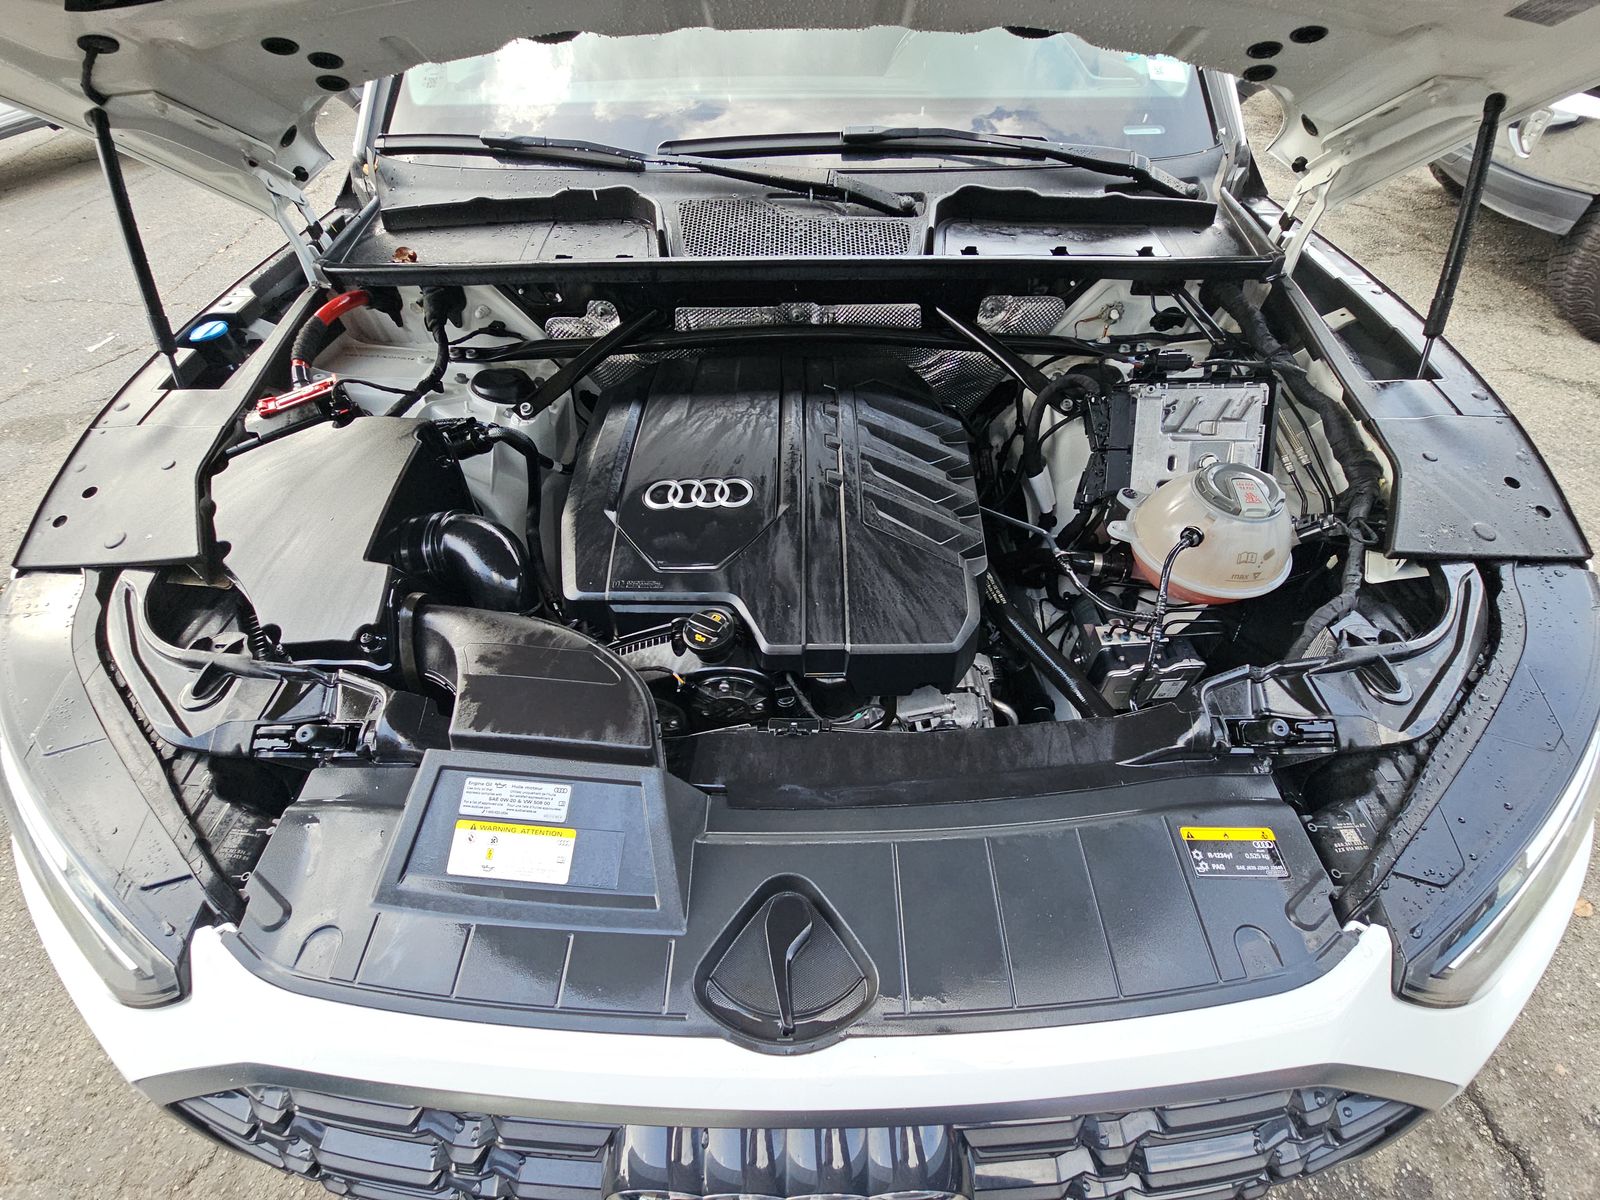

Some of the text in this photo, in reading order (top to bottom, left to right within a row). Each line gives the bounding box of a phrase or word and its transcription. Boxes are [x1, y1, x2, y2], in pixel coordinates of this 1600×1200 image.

[480, 825, 563, 837] WARNING ATTENTION
[1207, 852, 1233, 860] R-1234yf
